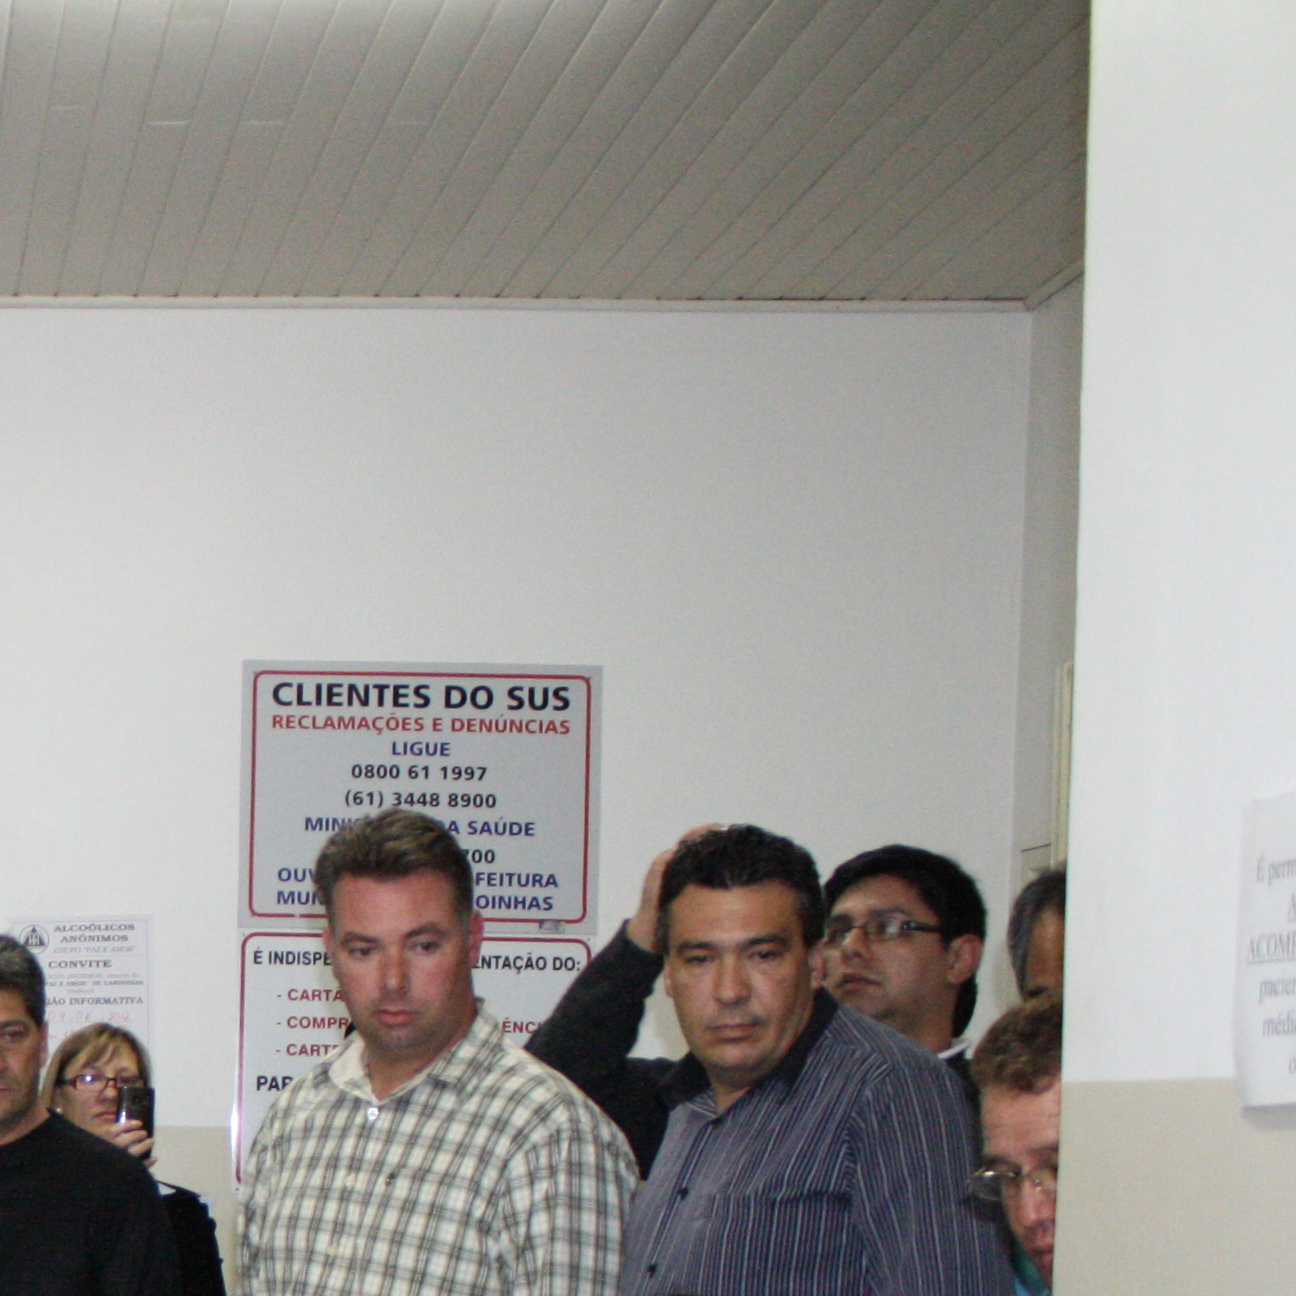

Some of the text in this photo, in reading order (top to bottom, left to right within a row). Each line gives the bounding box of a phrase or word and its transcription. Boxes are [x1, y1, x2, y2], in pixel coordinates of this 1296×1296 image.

[271, 681, 572, 712] CLIENTES DO SUS
[271, 711, 571, 736] RECLAMAÇÕES E DENÚNCIAS
[391, 740, 452, 758] LIGUE
[350, 763, 488, 782] 0800 61 1997
[344, 788, 497, 810] (61) 3448 8900
[304, 815, 351, 833] MIN
[466, 816, 536, 838] SAÚDE
[474, 871, 559, 889] FEITURA
[475, 894, 554, 912] OINHAS
[53, 922, 136, 933] ALCOÓLICOS
[60, 934, 130, 944] ANÔNIMOS
[48, 960, 113, 969] CONVITE
[253, 946, 263, 965] É
[471, 952, 547, 975] NTAÇÃO
[552, 956, 581, 972] DO:
[69, 996, 144, 1006] INFORMATIVA
